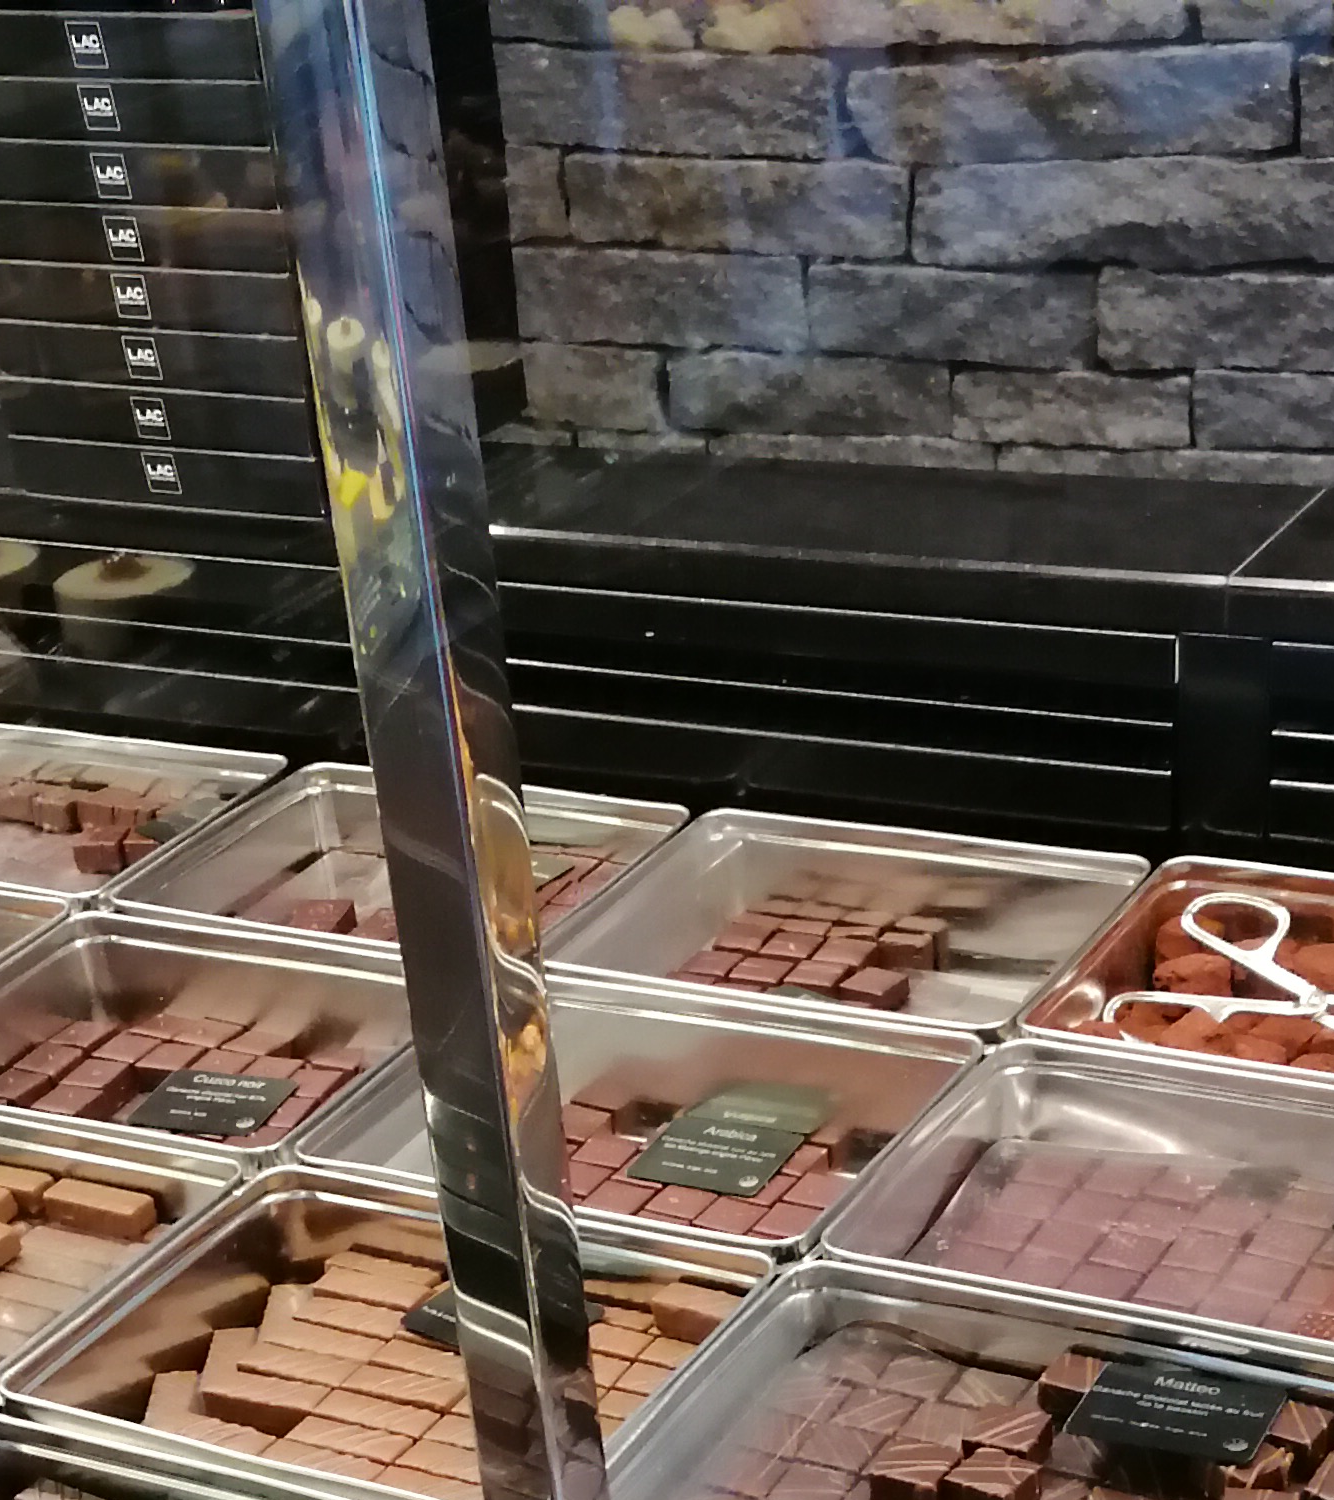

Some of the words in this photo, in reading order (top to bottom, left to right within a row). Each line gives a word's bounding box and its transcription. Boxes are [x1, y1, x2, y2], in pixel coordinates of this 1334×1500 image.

[71, 34, 100, 48] LAC
[83, 97, 112, 111] LAC
[95, 165, 124, 180] LAC
[108, 228, 137, 242] LAC
[116, 286, 144, 300] LAC
[127, 348, 155, 361] LAC
[136, 408, 164, 422] LAC
[147, 463, 174, 477] LAC
[1154, 1376, 1221, 1396] Matteo
